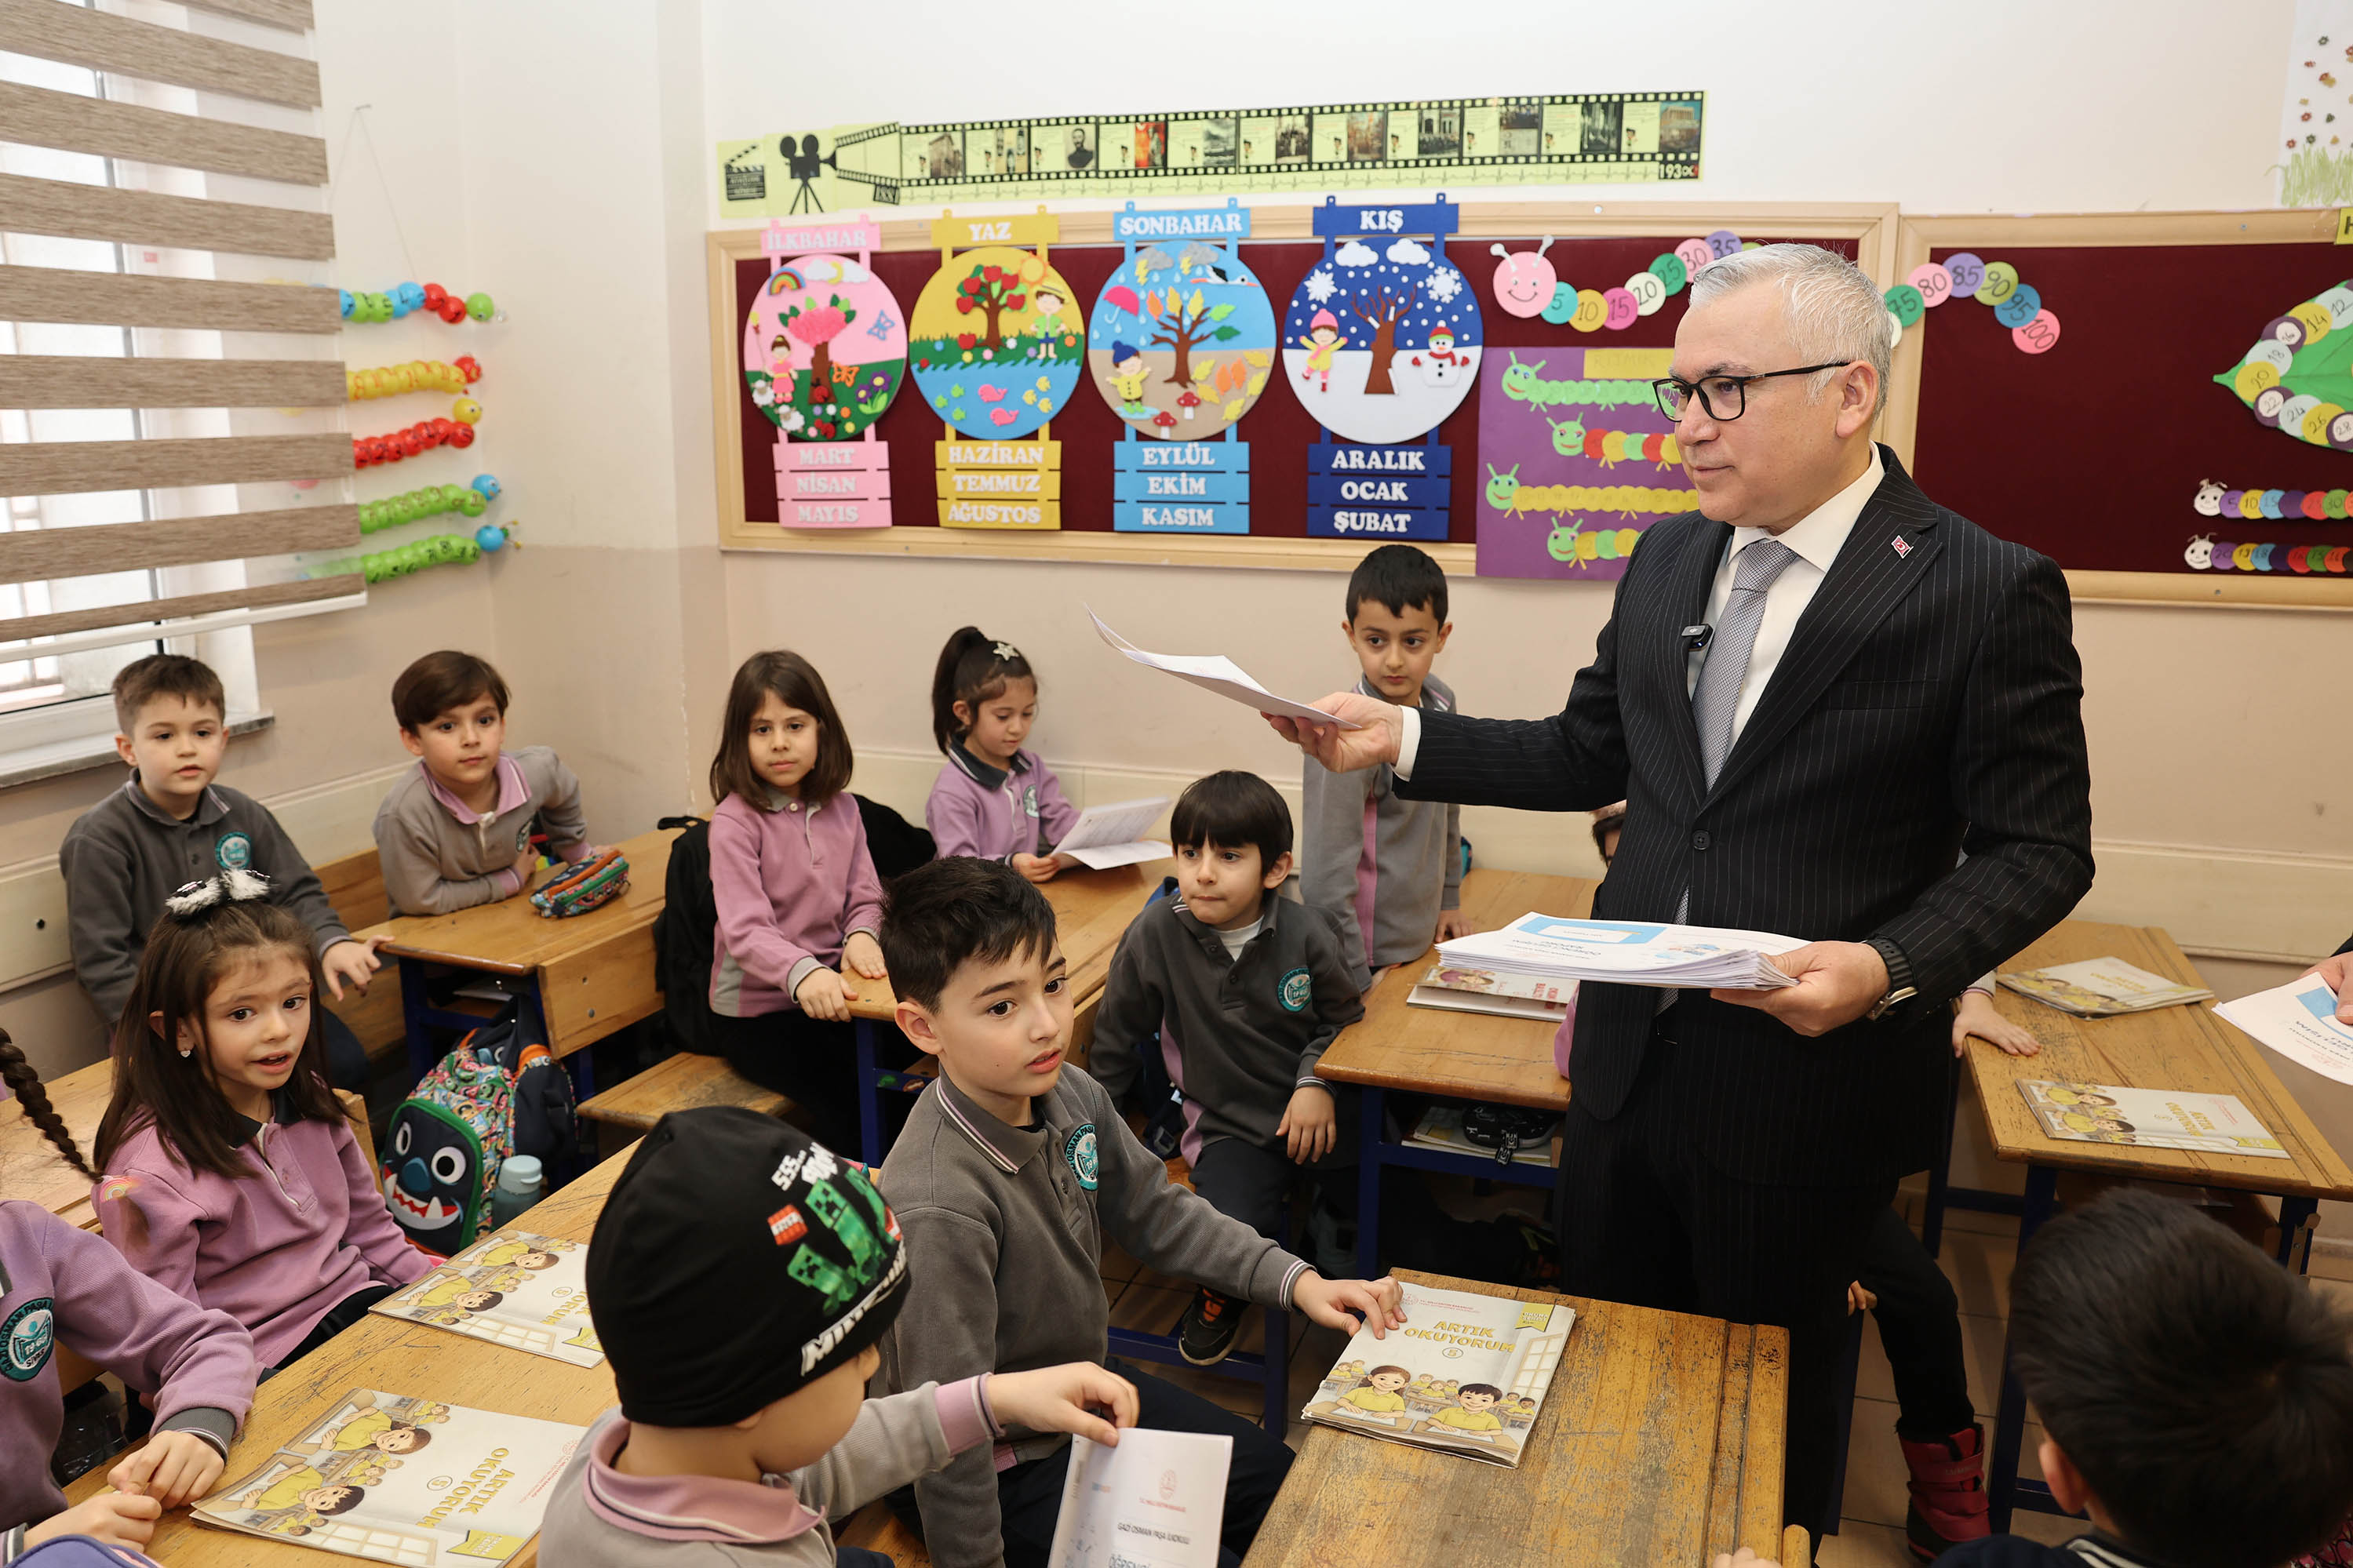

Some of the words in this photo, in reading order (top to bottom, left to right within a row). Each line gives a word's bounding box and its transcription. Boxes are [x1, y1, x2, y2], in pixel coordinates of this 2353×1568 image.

[968, 222, 1012, 242] YAZ
[1120, 213, 1243, 236] SONBAHAR
[1360, 209, 1404, 234] KIŞ
[766, 229, 867, 251] İLKBAHAR
[1551, 293, 1564, 311] 5
[1578, 301, 1599, 322] 10
[1609, 296, 1631, 321] 15
[1633, 281, 1658, 306] 20
[1659, 259, 1681, 288] 25
[1682, 247, 1708, 271] 30
[1711, 238, 1737, 260] 35
[1887, 290, 1918, 318] 75
[1918, 272, 1947, 298] 80
[1951, 265, 1983, 287] 85
[1981, 271, 2011, 297] 90
[2002, 293, 2034, 322] 95
[2021, 319, 2056, 350] 100
[2330, 298, 2353, 317] 12
[2305, 314, 2328, 333] 14
[2287, 406, 2306, 423] 24
[799, 448, 855, 466] MART
[948, 442, 1044, 464] HAZİRAN
[1142, 442, 1215, 466] EYLÜL
[1331, 449, 1426, 471] ARALIK
[796, 471, 857, 494] NİSAN
[952, 475, 1041, 493] TEMMUZ
[1147, 473, 1206, 496] EKİM
[1340, 481, 1409, 502] OCAK
[797, 505, 860, 524] MAYIS
[948, 502, 1041, 524] AĞUSTOS
[1142, 508, 1215, 527] KASIM
[1334, 511, 1411, 533] ŞUBAT
[1404, 1328, 1516, 1353] OKUYORUM
[1433, 1321, 1495, 1338] ARTIK
[415, 1447, 509, 1529] OKUYORUM
[459, 1468, 515, 1515] ARTIK
